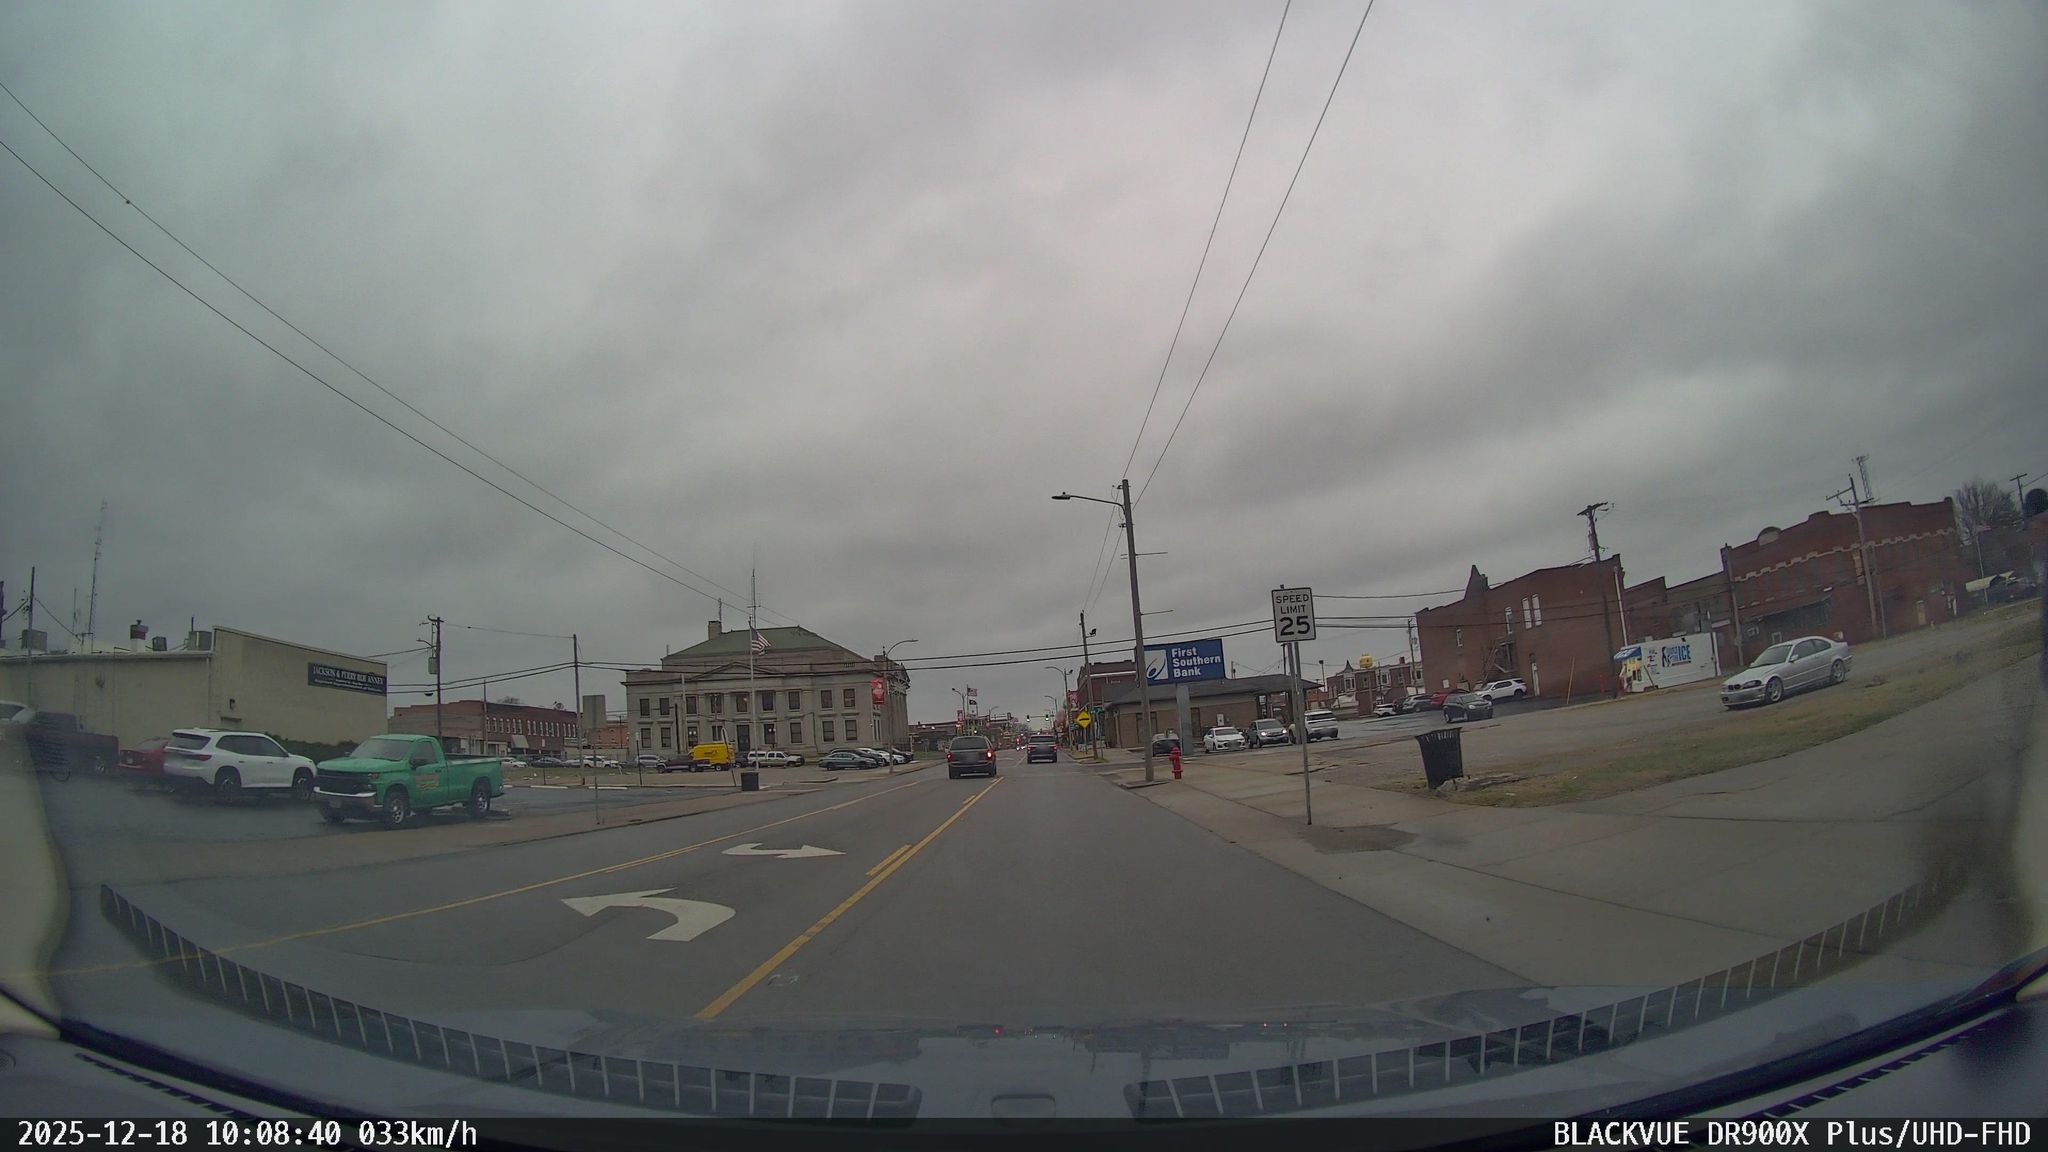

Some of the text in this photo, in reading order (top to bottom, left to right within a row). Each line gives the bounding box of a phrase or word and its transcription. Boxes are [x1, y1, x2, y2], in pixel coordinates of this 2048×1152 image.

[1275, 594, 1309, 604] SPEED
[1280, 604, 1306, 614] LIMIT
[1279, 615, 1311, 636] 25
[1171, 646, 1198, 657] First
[1678, 644, 1691, 660] ICE
[1172, 655, 1221, 668] Southern
[313, 666, 336, 677] JACKSON
[1173, 666, 1201, 678] Bank
